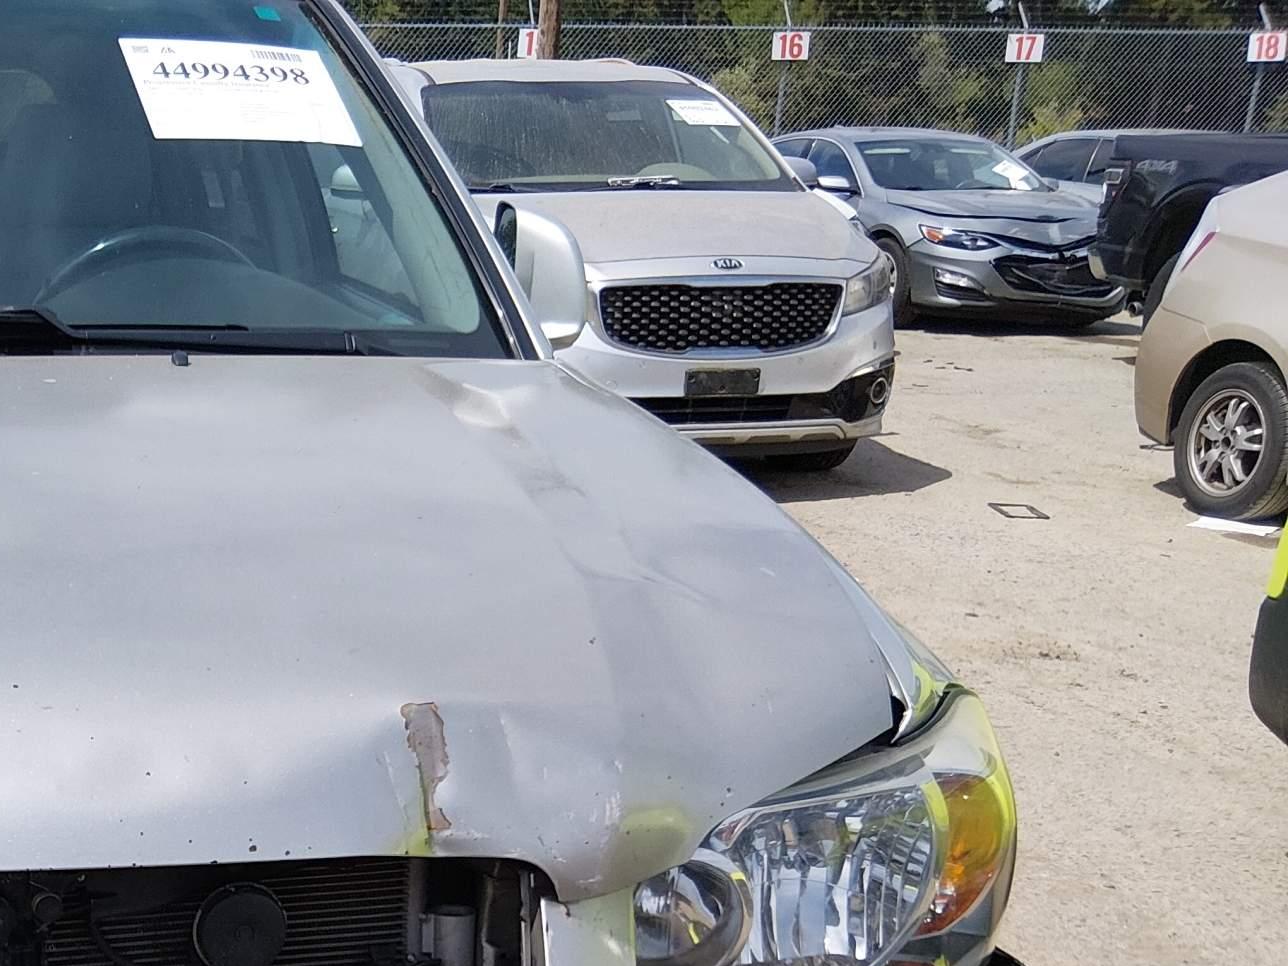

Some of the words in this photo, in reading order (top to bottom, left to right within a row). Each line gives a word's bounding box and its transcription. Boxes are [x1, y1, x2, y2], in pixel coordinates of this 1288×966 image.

[526, 31, 534, 56] 1
[779, 33, 803, 59] 16
[1015, 36, 1037, 61] 17
[1255, 35, 1280, 60] 18
[152, 61, 310, 86] 44994398
[712, 259, 742, 269] KIA
